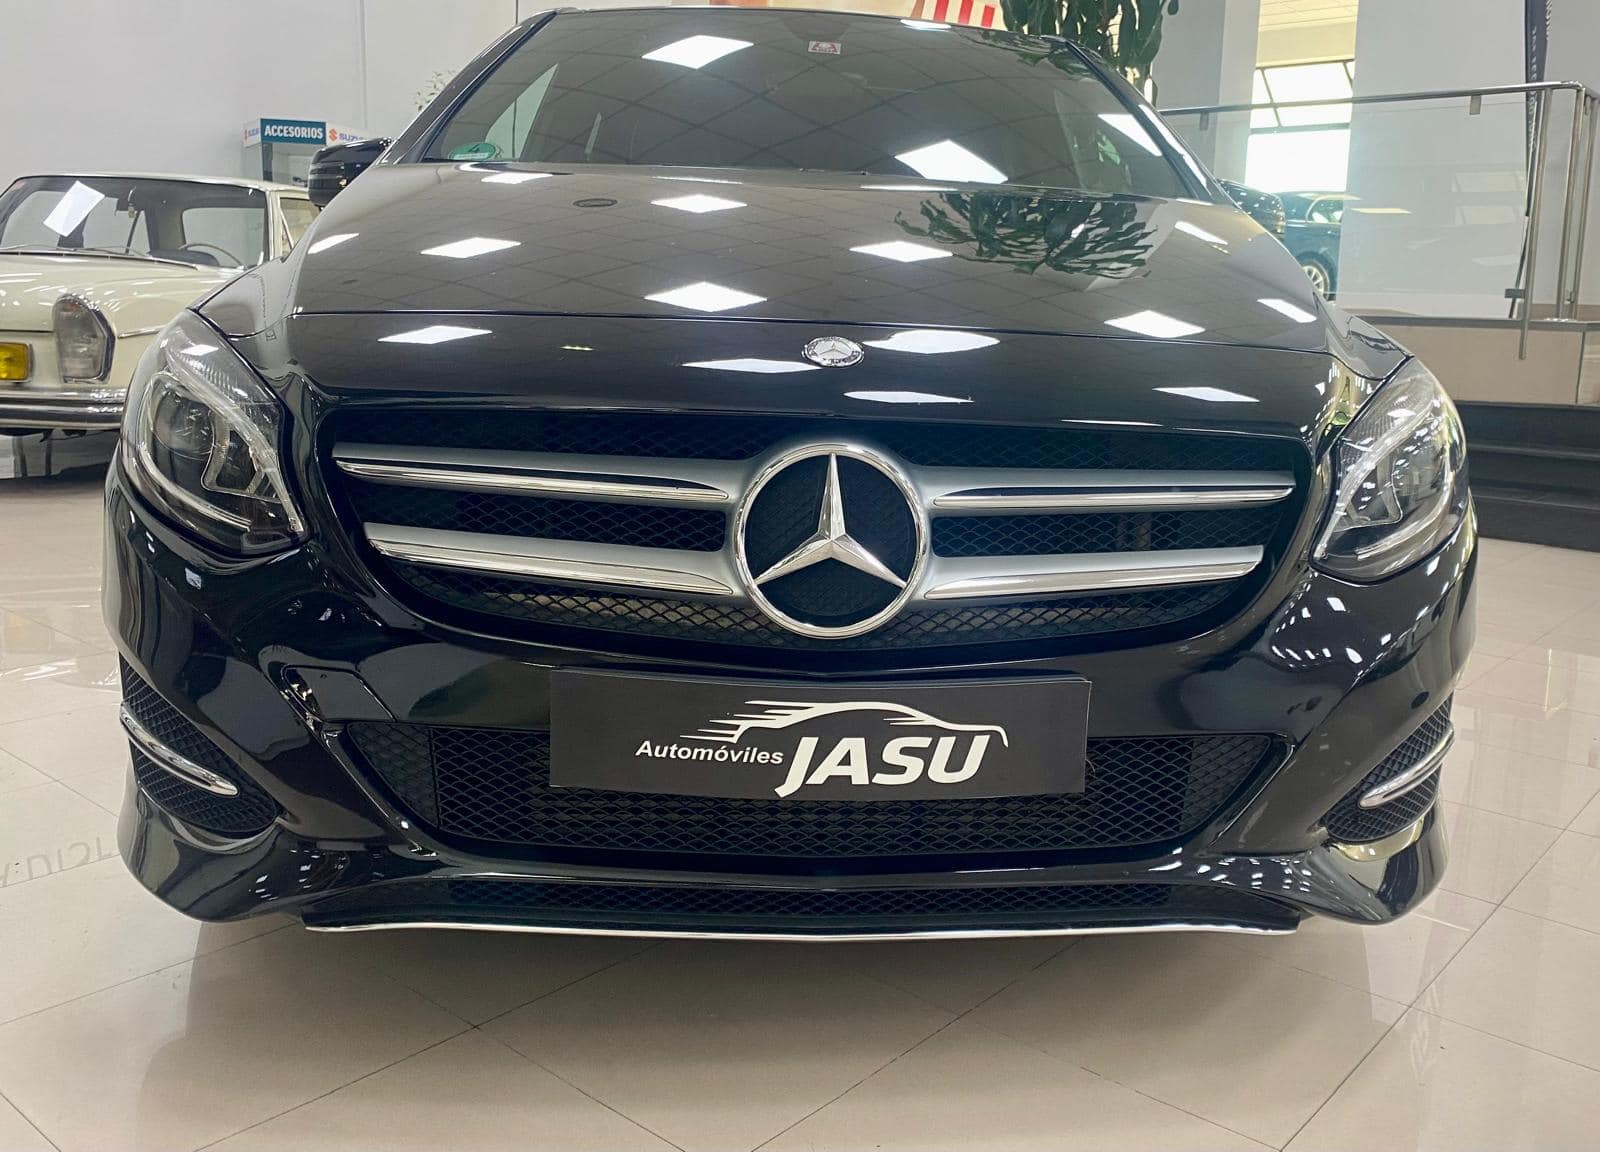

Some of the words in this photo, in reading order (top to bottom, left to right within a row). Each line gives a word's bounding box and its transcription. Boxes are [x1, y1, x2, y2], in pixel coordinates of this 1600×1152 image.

[264, 124, 323, 139] ACCESORIOS
[635, 740, 784, 765] Automóviles
[774, 734, 991, 799] JASU
